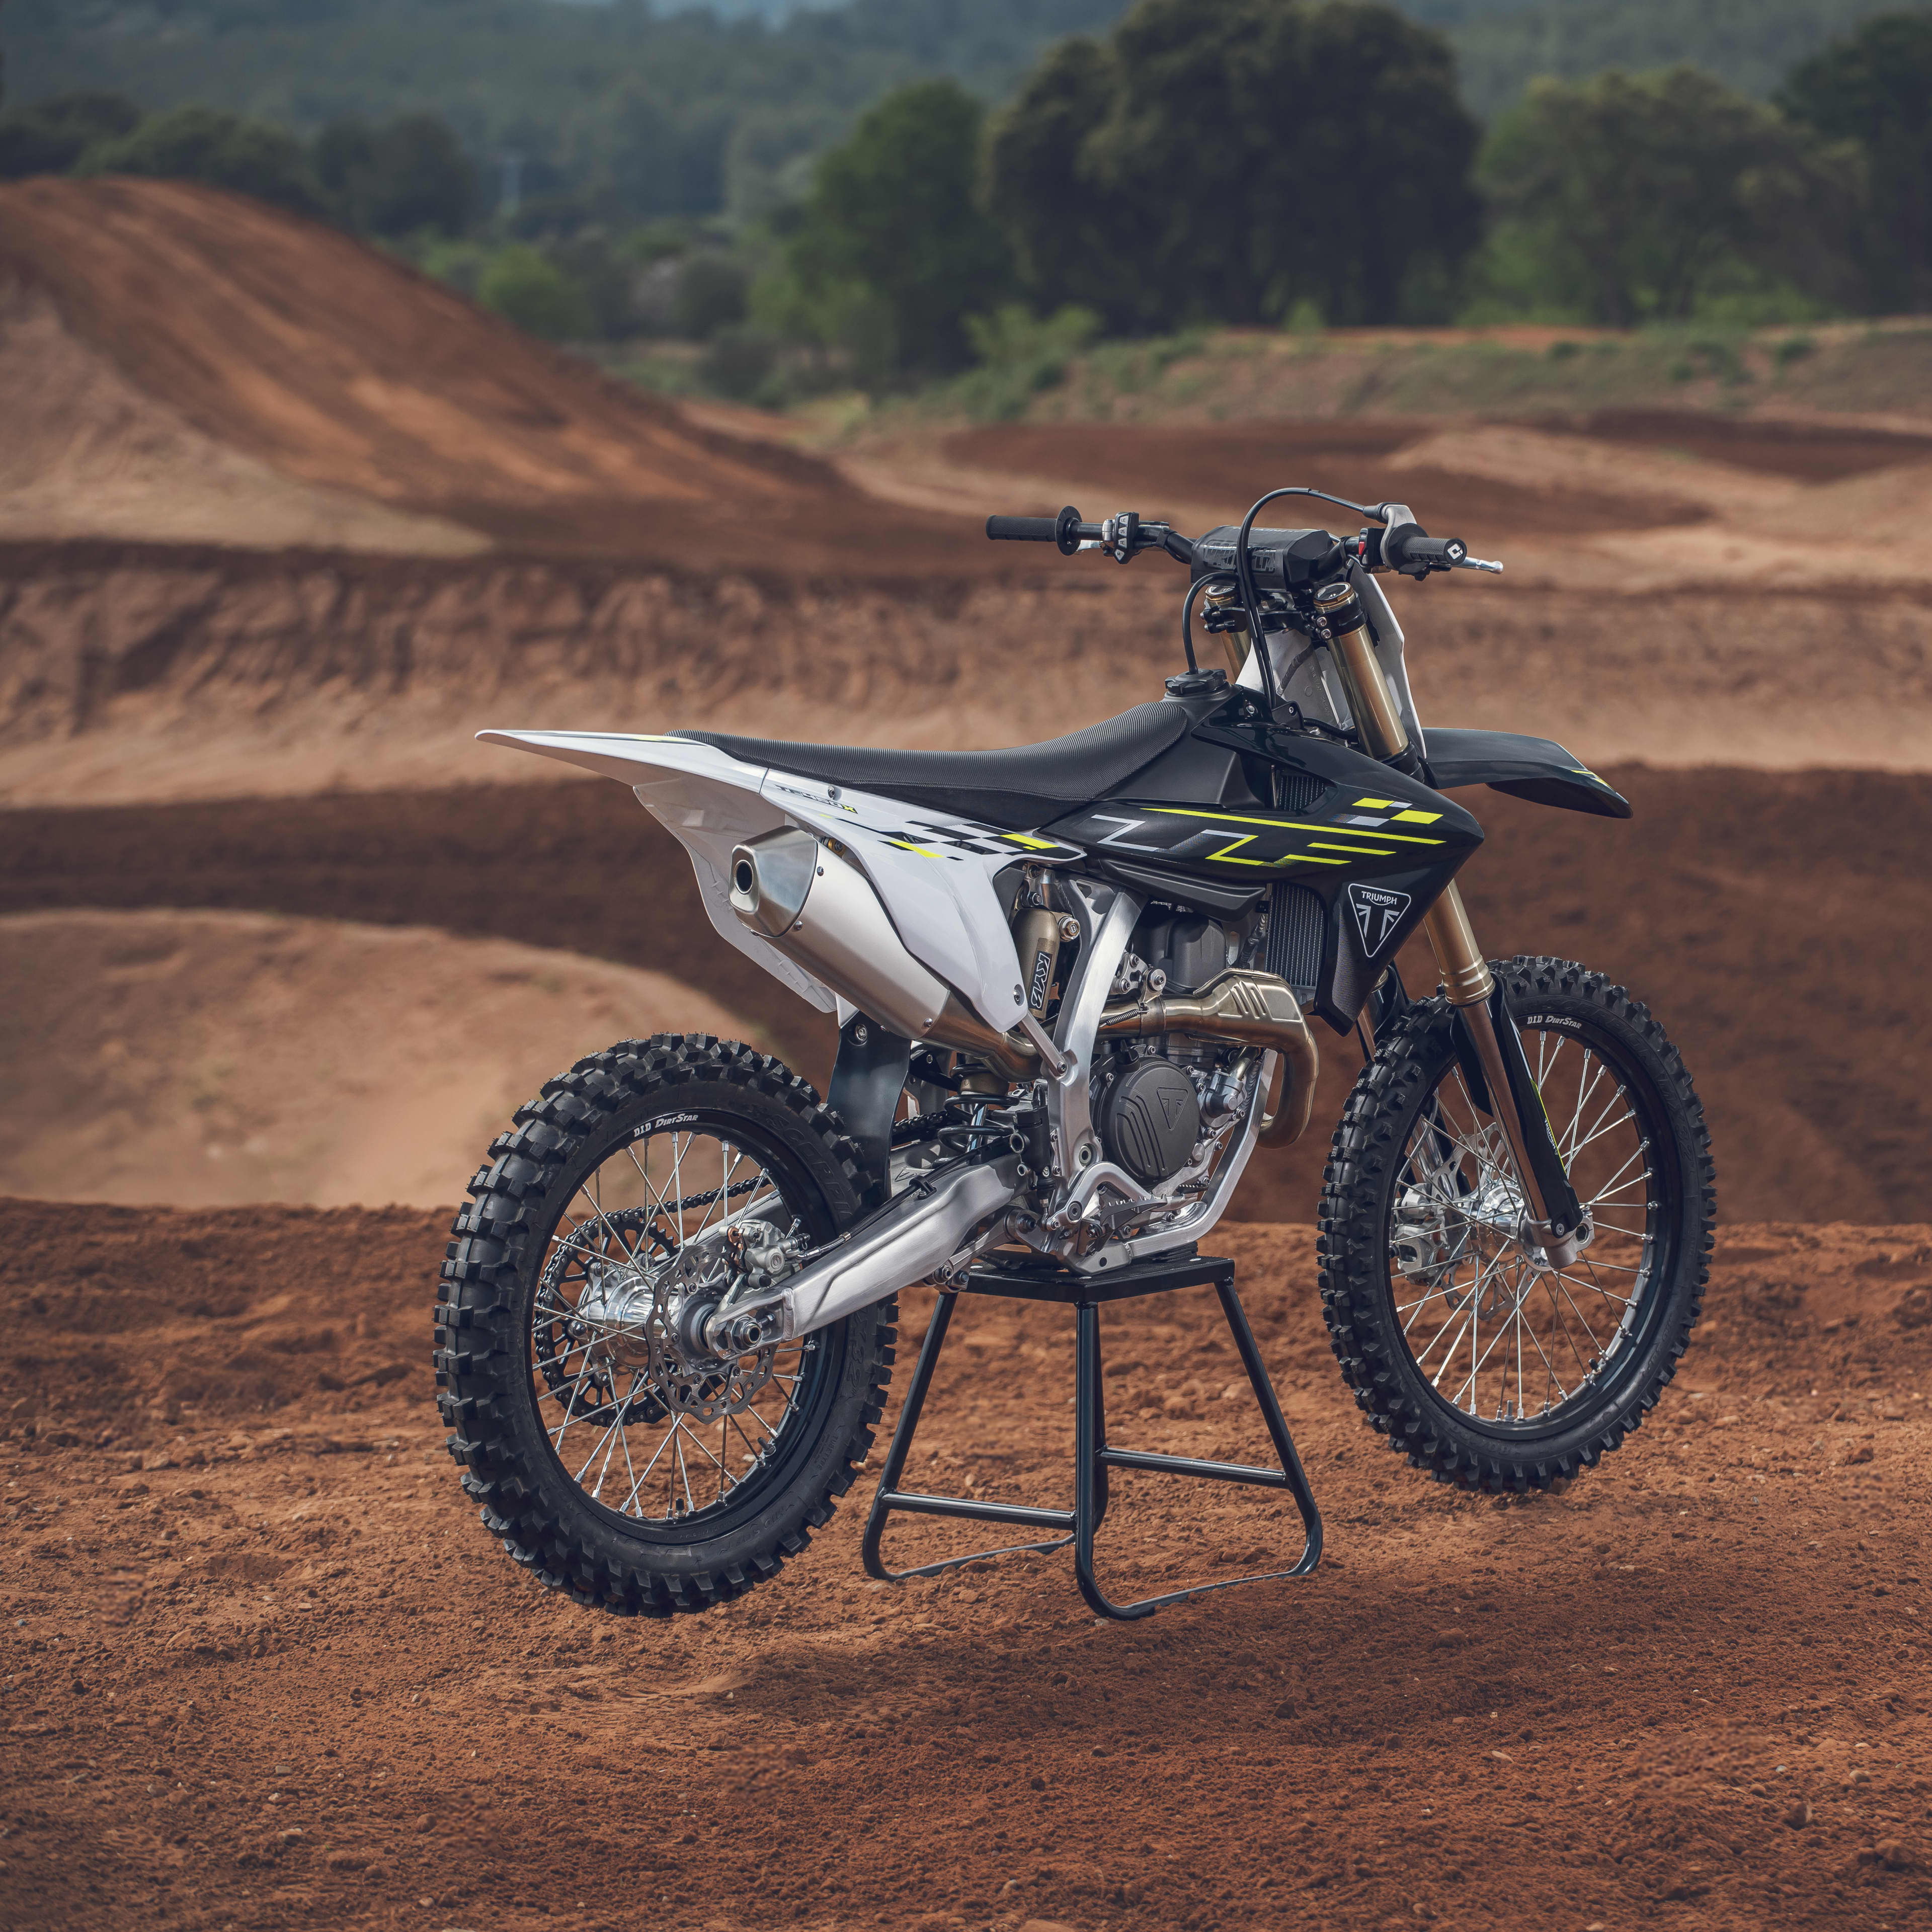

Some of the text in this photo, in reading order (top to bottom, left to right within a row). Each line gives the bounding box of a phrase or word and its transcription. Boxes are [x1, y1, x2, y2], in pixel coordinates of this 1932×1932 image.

[1361, 891, 1397, 905] TRIUMPH
[1031, 952, 1051, 1008] KYB
[633, 1122, 651, 1138] D.I.D
[1544, 1118, 1556, 1149] TRIUMPH
